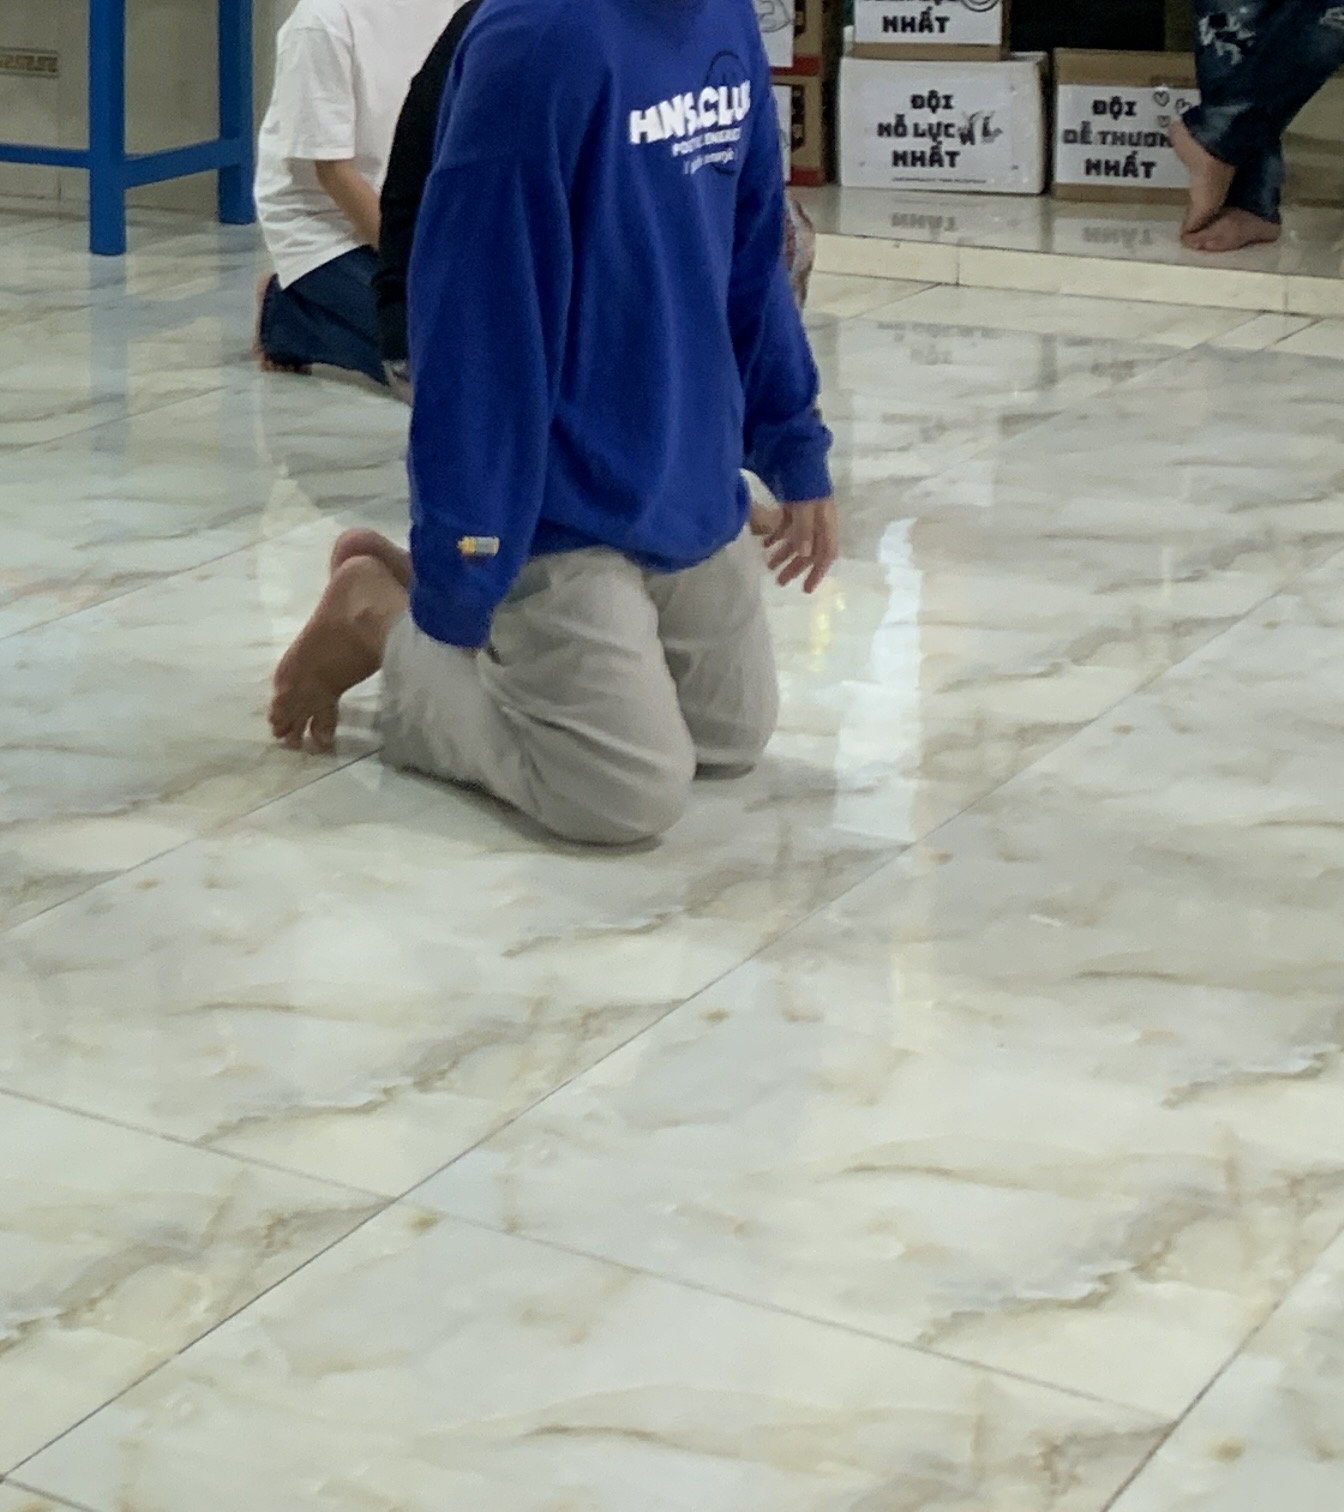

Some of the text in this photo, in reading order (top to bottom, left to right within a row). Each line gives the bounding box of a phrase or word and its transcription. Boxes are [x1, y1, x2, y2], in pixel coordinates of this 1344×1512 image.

[881, 6, 950, 33] NHẤT
[910, 89, 954, 114] ĐỘI
[1092, 96, 1137, 120] ĐỘI
[913, 121, 955, 142] LỰC
[891, 140, 961, 168] NHẤT
[1085, 150, 1157, 179] NHẤT
